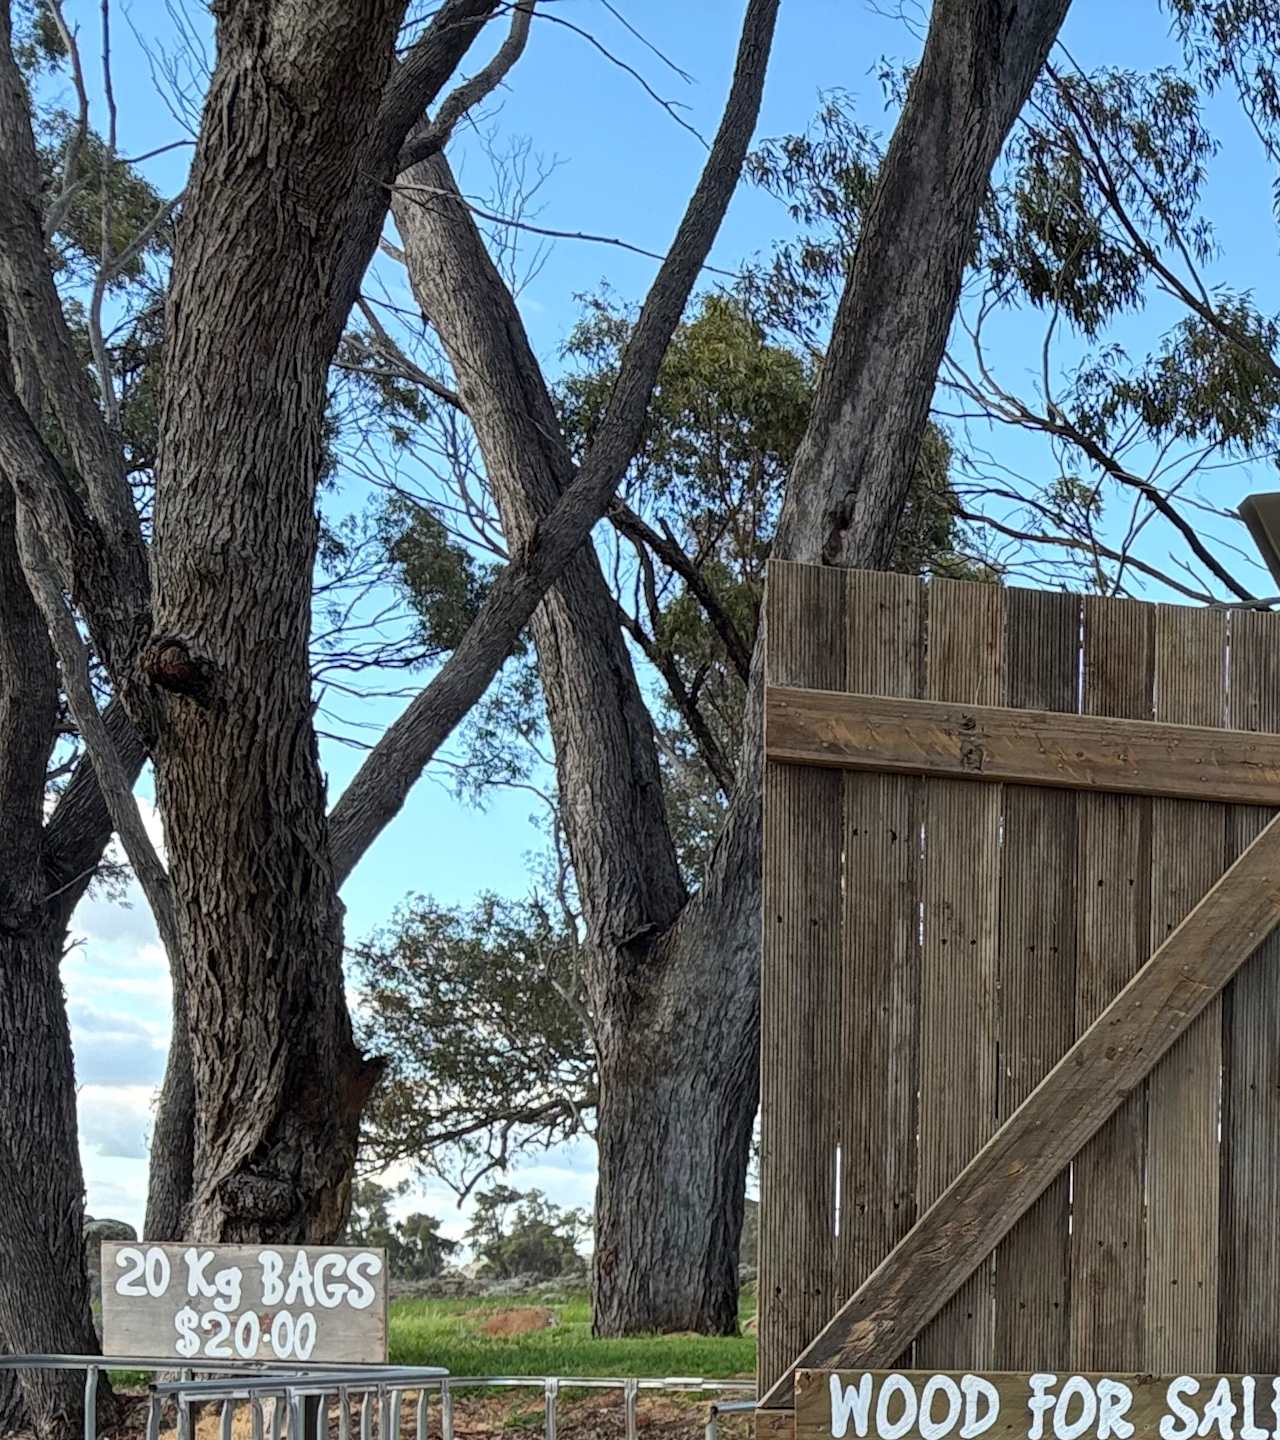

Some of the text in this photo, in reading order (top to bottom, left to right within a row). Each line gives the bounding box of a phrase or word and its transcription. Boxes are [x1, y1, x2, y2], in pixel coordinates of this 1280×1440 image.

[115, 1247, 382, 1312] 20 Kg BAGS
[830, 1373, 1000, 1440] WOOD
[1027, 1373, 1135, 1440] FOR
